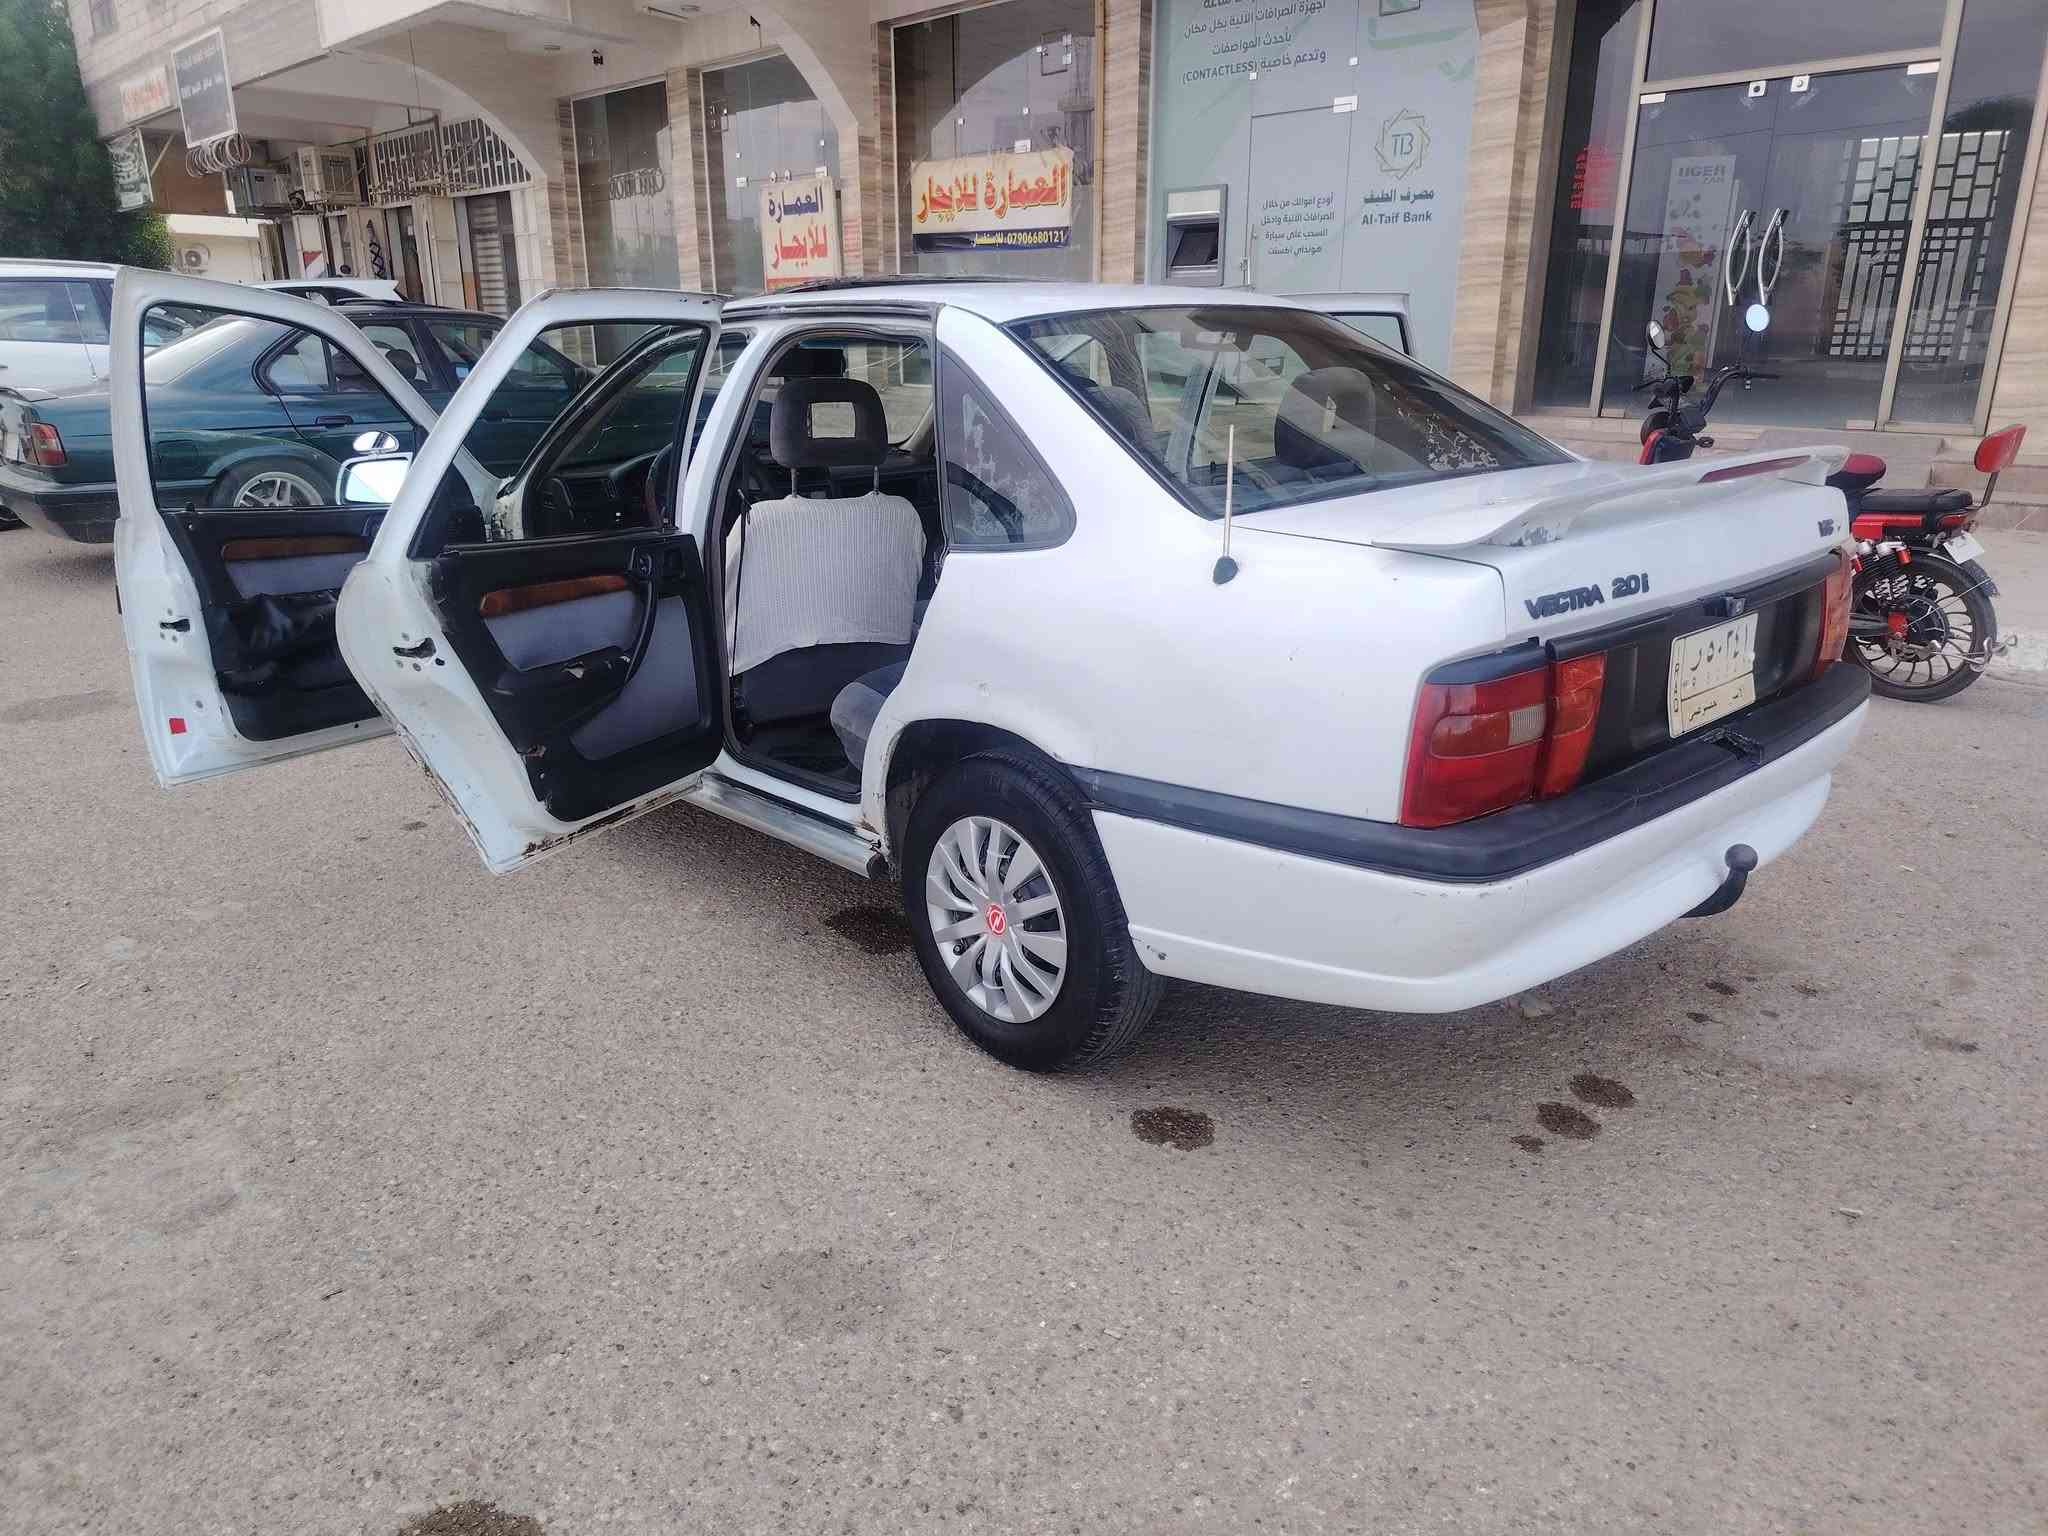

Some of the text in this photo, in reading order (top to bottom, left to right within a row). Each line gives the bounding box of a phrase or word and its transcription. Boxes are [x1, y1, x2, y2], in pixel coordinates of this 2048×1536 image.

[1184, 23, 1207, 40] مكان
[1212, 36, 1261, 56] المواصفات
[1182, 61, 1258, 85] (CONTACTLESS)
[983, 160, 1072, 219] العمارة
[768, 185, 823, 224] العمارة
[1361, 210, 1433, 225] Al-Taif Bank
[1007, 229, 1065, 245] 07906680121
[1524, 583, 1605, 620] VECTRA
